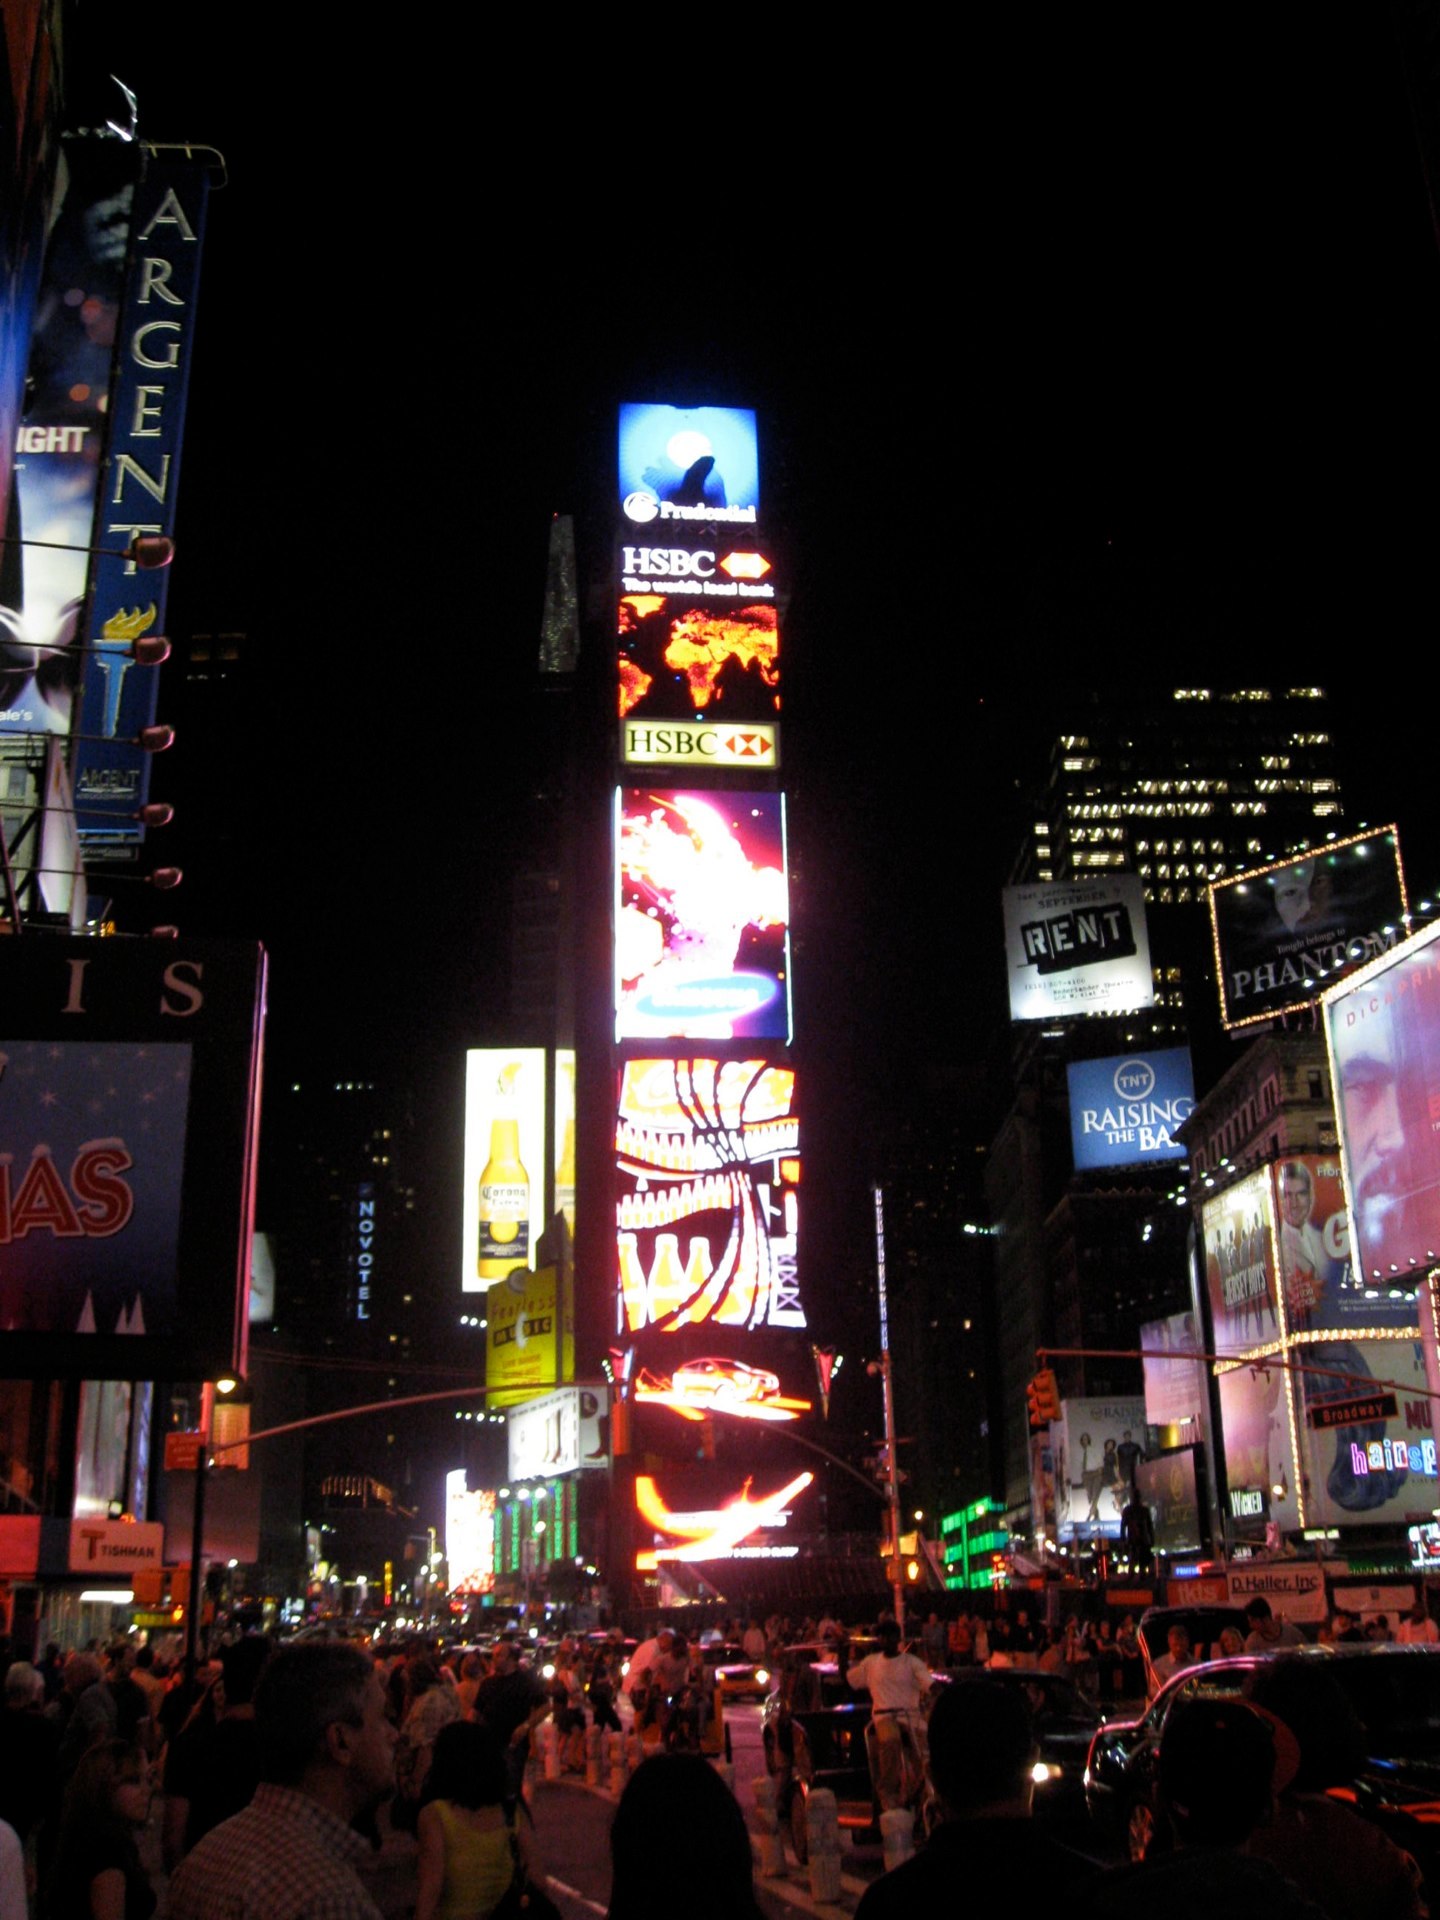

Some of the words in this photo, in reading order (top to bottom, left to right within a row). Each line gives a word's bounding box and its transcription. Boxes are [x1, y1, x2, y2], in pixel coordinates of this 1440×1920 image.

[108, 187, 197, 575] ARGENT
[660, 501, 756, 523] Prudential
[622, 546, 716, 577] HSBC
[628, 729, 718, 756] HSBC
[1025, 910, 1121, 956] RENT
[1277, 938, 1305, 954] Tonight
[1306, 931, 1335, 948] belongs
[1336, 927, 1346, 936] to
[1232, 930, 1397, 999] PHANTOM
[1120, 1074, 1149, 1088] TNT
[1082, 1097, 1195, 1134] RAISING
[1105, 1129, 1136, 1145] THE
[1138, 1122, 1182, 1152] BA
[482, 1186, 526, 1200] Corona
[357, 1201, 375, 1319] NOVOTEL
[1322, 1403, 1383, 1423] Broadway
[1230, 1490, 1263, 1518] WICKED
[102, 1544, 155, 1559] TISHMAN
